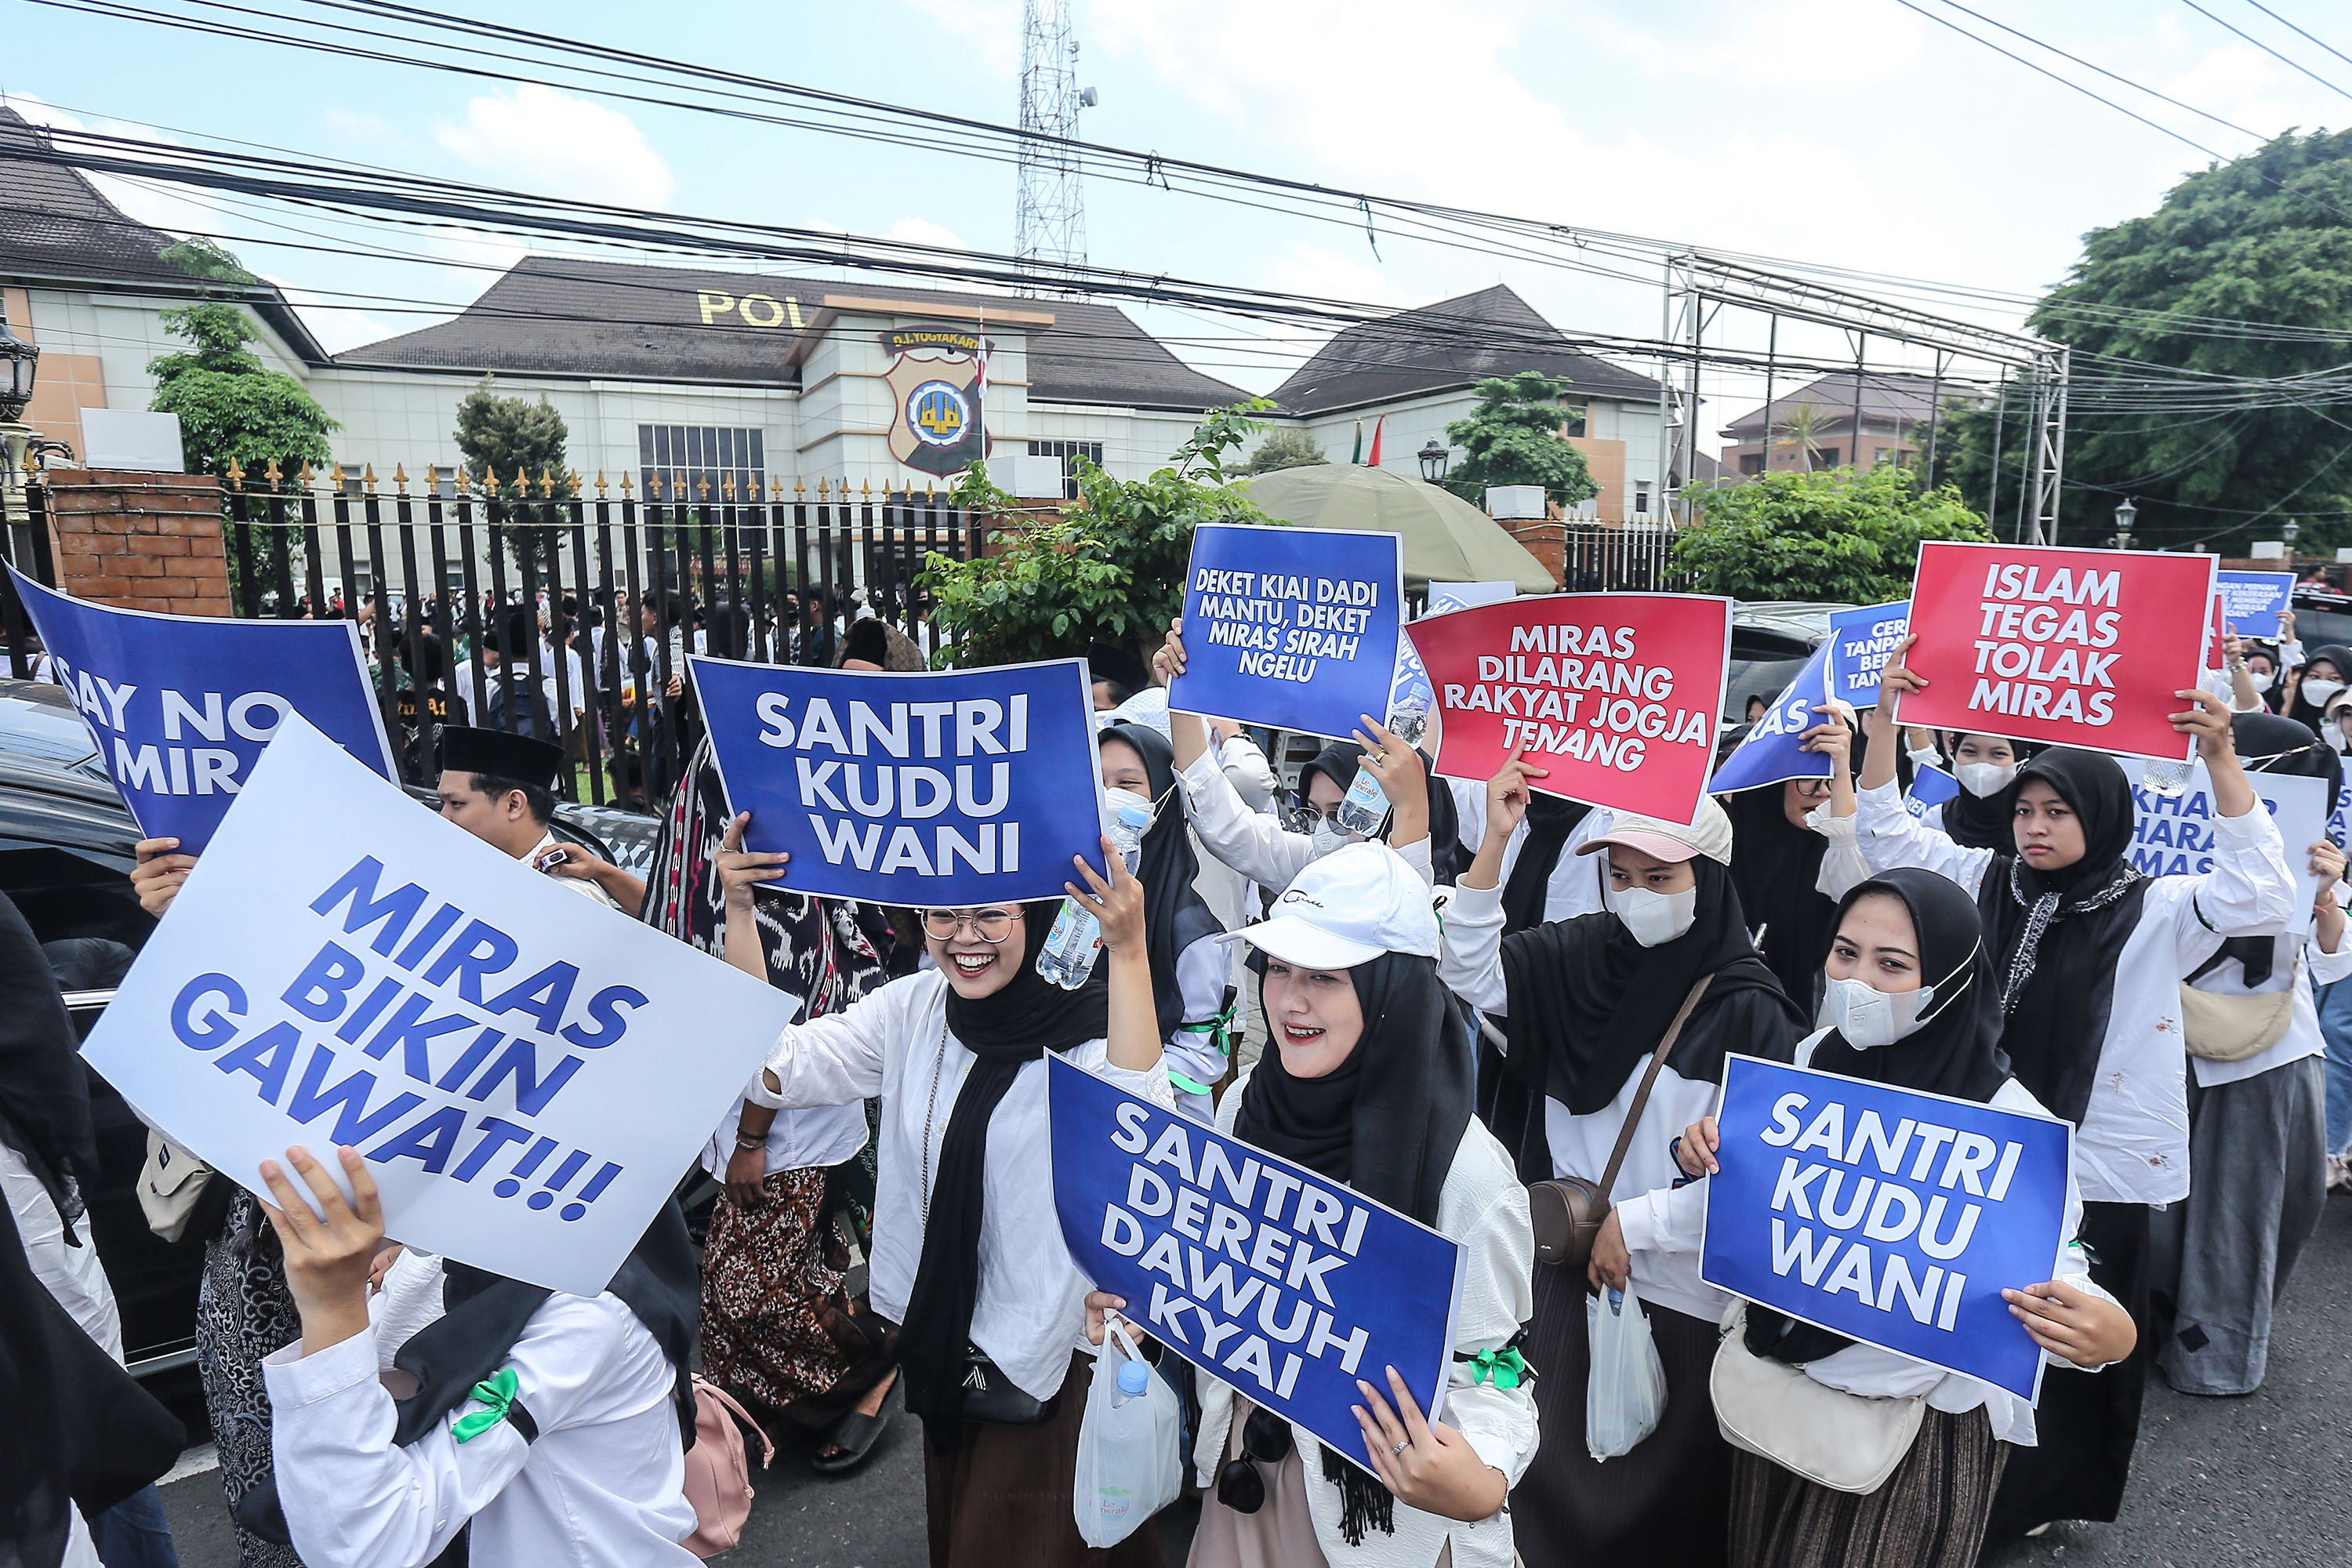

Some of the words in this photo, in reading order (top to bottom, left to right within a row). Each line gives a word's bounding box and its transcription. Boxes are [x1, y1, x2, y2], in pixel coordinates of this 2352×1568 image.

[1195, 568, 1255, 597] DEKET
[1261, 574, 1308, 602] KIAI
[1317, 579, 1378, 608] DADI
[1199, 595, 1290, 629] MANTU,
[1297, 603, 1371, 633] DEKET
[1982, 563, 2122, 608] ISLAM
[1208, 621, 1280, 652] MIRAS
[1284, 630, 1359, 661] SIRAH
[1510, 625, 1636, 660] MIRAS
[1844, 635, 1904, 658] TANPA
[1979, 602, 2122, 648] TEGAS
[1238, 651, 1317, 683] NGELU
[1478, 655, 1675, 702] DILARANG
[1973, 640, 2122, 688] TOLAK
[161, 690, 292, 742] NO
[755, 691, 1029, 758] SANTRI
[1444, 684, 1584, 724] RAKYAT
[1589, 697, 1708, 748] JOGJA
[1967, 679, 2116, 726] MIRAS
[114, 736, 270, 796] MIR
[1502, 718, 1646, 771] TENANG
[795, 757, 1010, 818] KUDU
[808, 813, 1020, 877] WANI
[308, 854, 649, 1050] MIRAS
[279, 939, 586, 1117] BIKIN
[169, 971, 623, 1222] GAWAT!!!
[1759, 1091, 2024, 1202] SANTRI
[1109, 1101, 1370, 1258] SANTRI
[1770, 1156, 1982, 1261] KUDU
[1126, 1161, 1348, 1308] DEREK
[1100, 1202, 1370, 1376] DAWUH
[1771, 1217, 1967, 1333] WANI
[1148, 1282, 1303, 1401] KYAI
